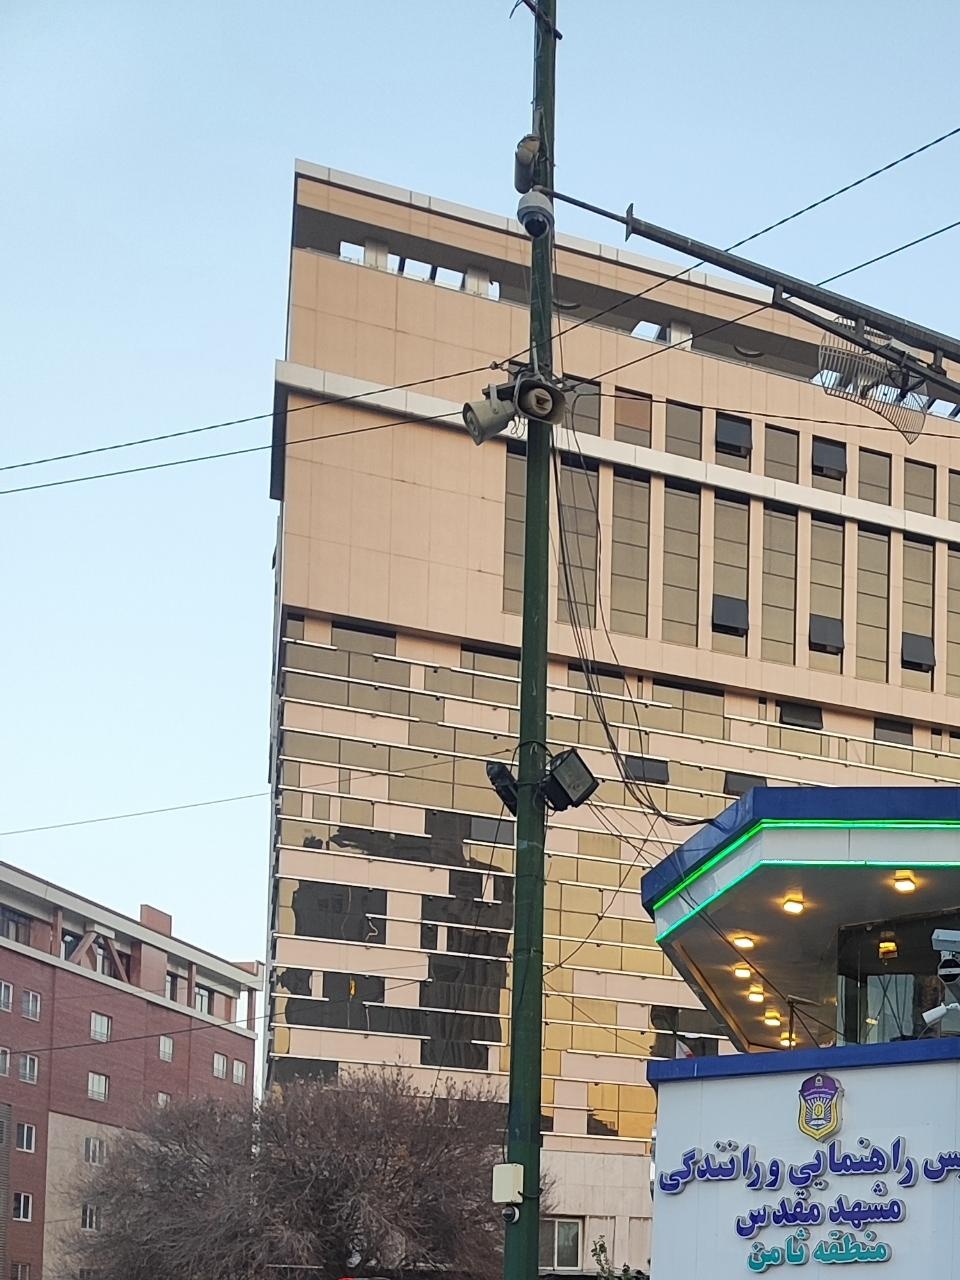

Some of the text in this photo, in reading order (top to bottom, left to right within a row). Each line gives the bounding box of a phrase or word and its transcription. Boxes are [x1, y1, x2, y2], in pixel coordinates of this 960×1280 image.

[658, 1138, 763, 1195] رانندگی
[763, 1156, 784, 1190] و
[787, 1134, 918, 1191] راهنمایی
[735, 1180, 906, 1239] مشهد مقدس
[746, 1227, 892, 1273] منطقه ثامن
